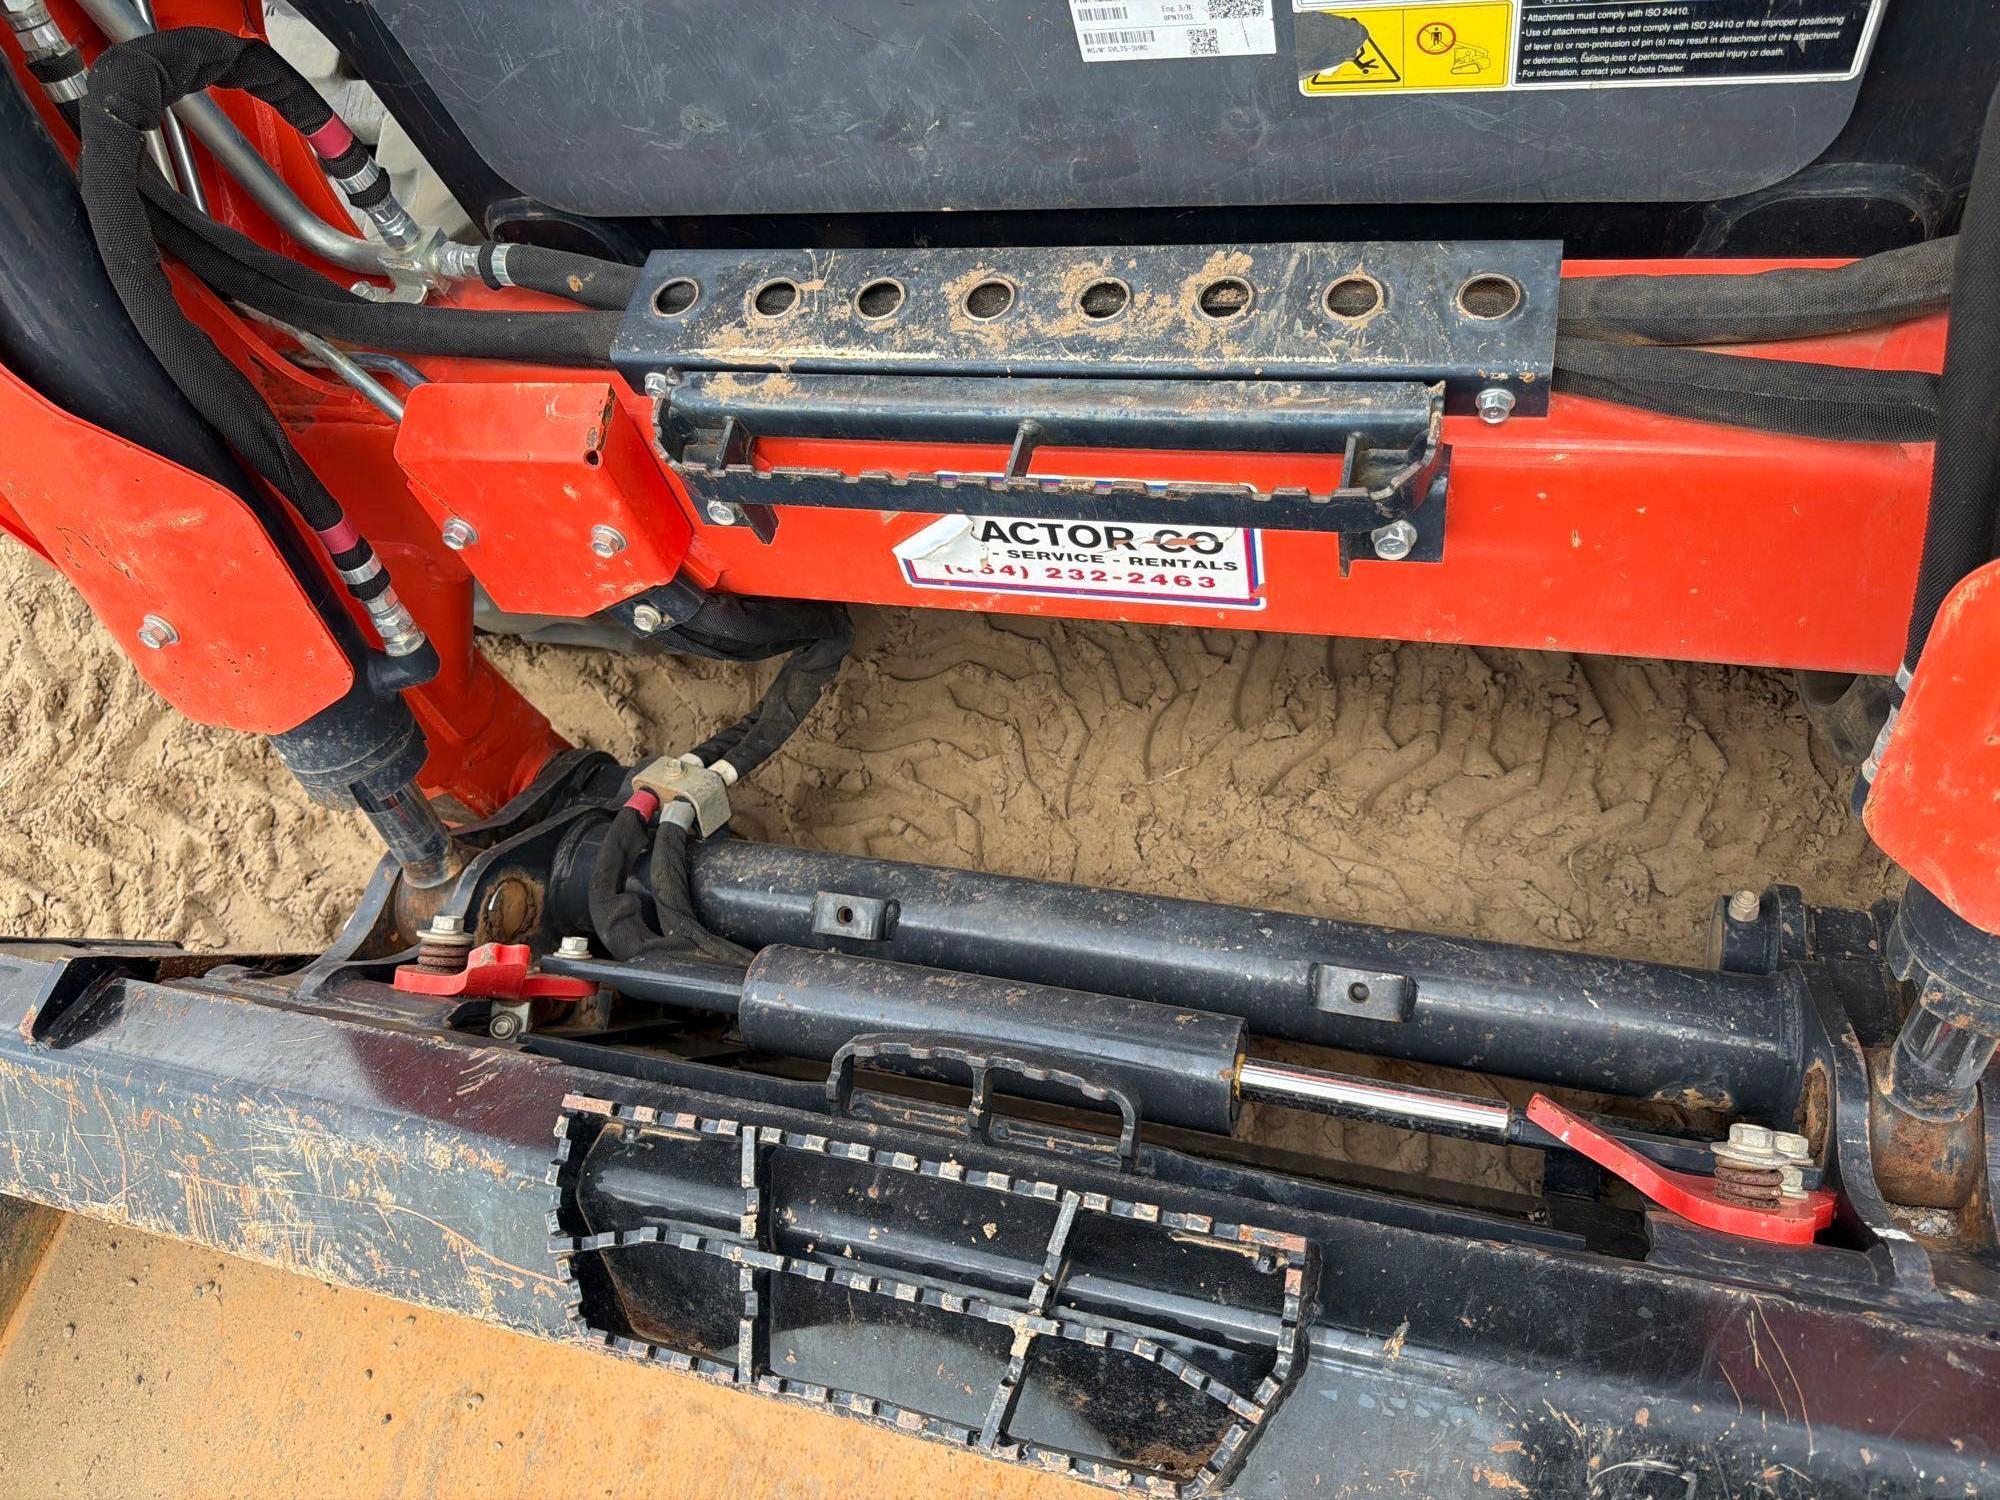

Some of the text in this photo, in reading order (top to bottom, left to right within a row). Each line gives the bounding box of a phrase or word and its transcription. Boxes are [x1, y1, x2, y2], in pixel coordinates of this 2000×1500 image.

[1527, 7, 1689, 22] Attachments must comply with ISO 24410.
[1526, 29, 1540, 37] Use
[1542, 28, 1551, 36] of
[1552, 26, 1598, 36] attachments
[1600, 25, 1615, 34] that
[1617, 25, 1626, 33] do
[1628, 24, 1641, 32] not
[1644, 23, 1670, 34] comply
[1673, 22, 1688, 30] with
[1691, 21, 1706, 30] ISO
[1708, 20, 1734, 29] 24410
[1746, 19, 1760, 28] the
[1761, 18, 1798, 29] improper
[1799, 16, 1844, 28] positioning
[1524, 42, 1533, 51] of
[1534, 42, 1552, 50] lever
[1554, 42, 1564, 51] (s)
[1575, 39, 1630, 50] non-protrusion
[1632, 38, 1640, 48] of
[1641, 38, 1654, 48] pin
[1656, 38, 1666, 47] (s)
[1668, 38, 1684, 46] may
[1686, 36, 1708, 45] result
[1710, 36, 1718, 44] in
[1720, 34, 1766, 44] detachment
[1768, 32, 1778, 42] of
[1778, 32, 1792, 41] the
[1794, 31, 1840, 41] attachment
[1532, 55, 1578, 65] deformation,
[1611, 53, 1626, 62] loss
[1628, 52, 1637, 62] of
[1638, 52, 1688, 62] performance,
[1690, 50, 1725, 61] personal
[1726, 49, 1748, 60] injury
[1760, 48, 1785, 57] death.
[1522, 65, 1684, 78] For information, contact your Kubota Dealer.
[980, 519, 1225, 555] ACTOR CO
[1007, 548, 1105, 565] SERVICE
[1129, 555, 1239, 572] RENTALS
[1045, 566, 1217, 589] 232-2463
